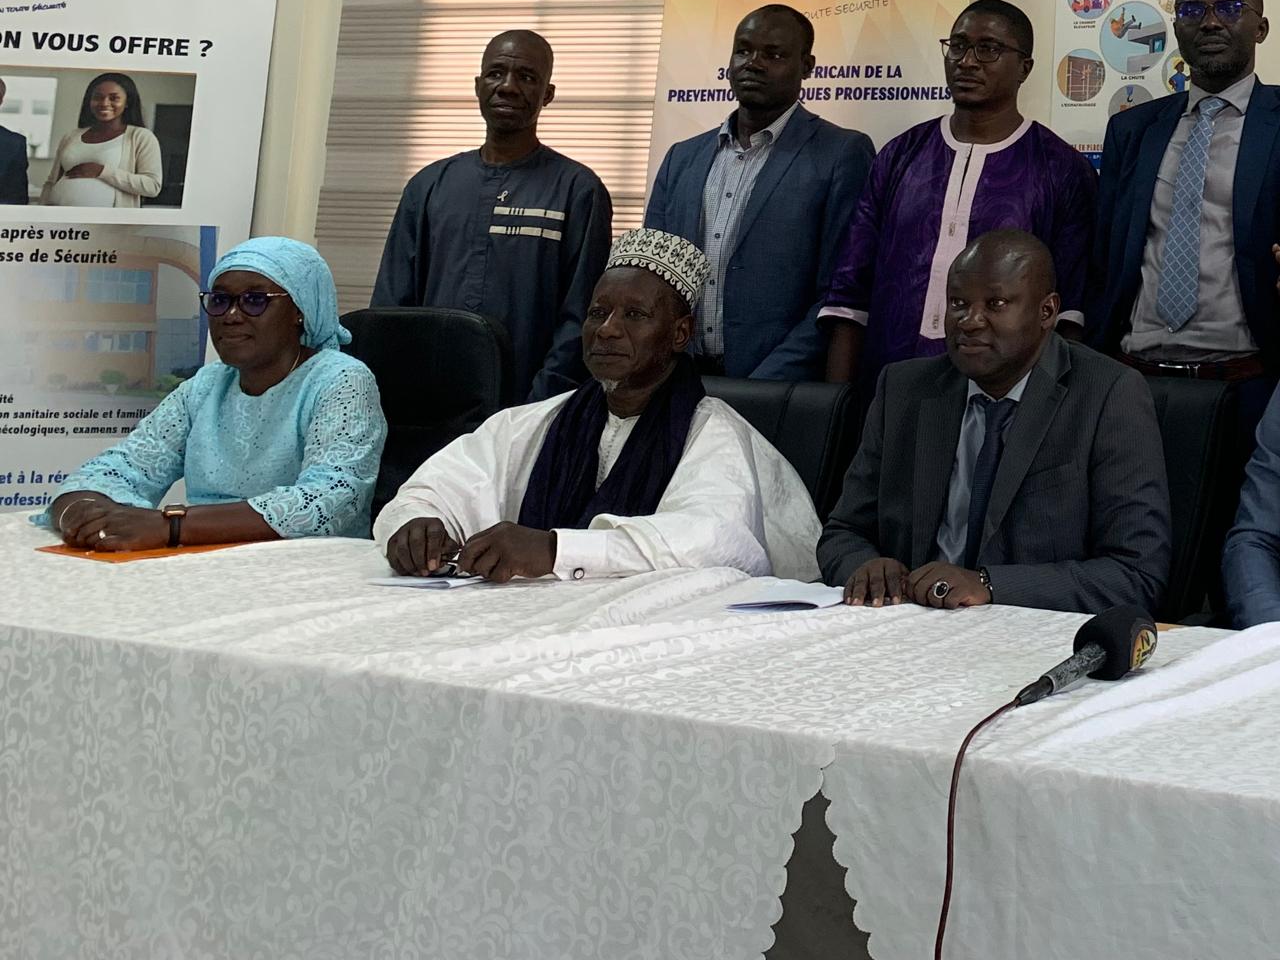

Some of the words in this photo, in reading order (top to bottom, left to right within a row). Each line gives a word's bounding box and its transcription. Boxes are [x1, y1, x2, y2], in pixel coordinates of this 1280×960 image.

[803, 7, 832, 20] OUTE
[32, 31, 99, 53] VOUS
[109, 36, 190, 57] OFFRE
[199, 39, 213, 58] ?
[864, 65, 883, 79] DE
[886, 65, 903, 79] LA
[667, 88, 738, 103] PREVENTIO
[834, 86, 951, 101] PROFESSIONNELS
[0, 225, 44, 243] après
[50, 227, 90, 241] votre
[29, 248, 49, 263] de
[54, 248, 118, 264] Sécurité
[13, 408, 60, 419] sanitaire
[63, 408, 99, 419] sociale
[102, 409, 113, 419] et
[72, 426, 118, 434] examens
[17, 470, 25, 484] à
[30, 470, 43, 484] la
